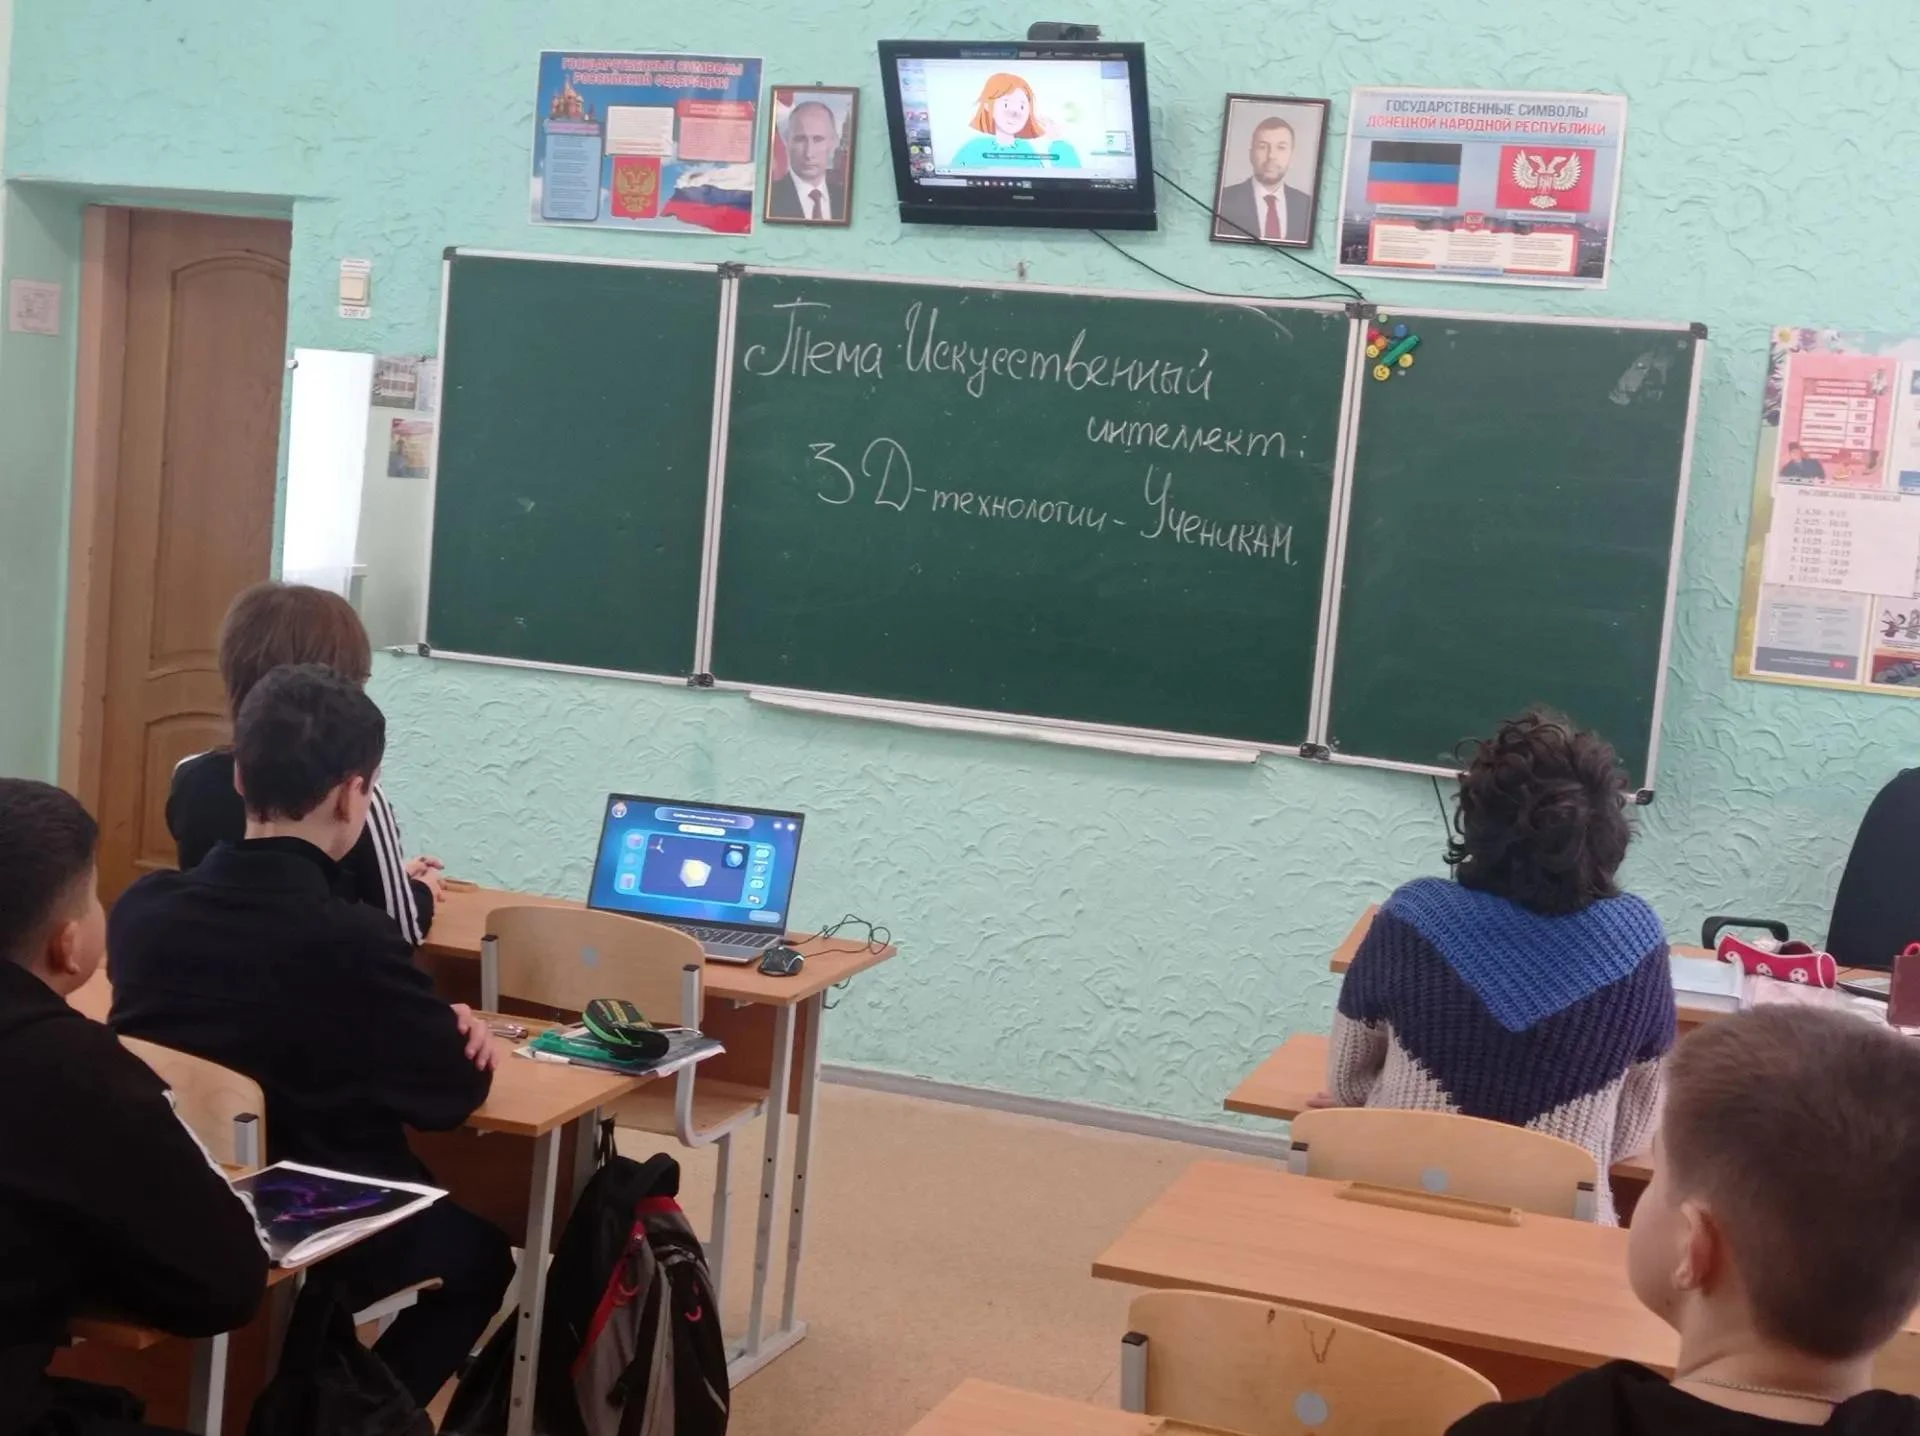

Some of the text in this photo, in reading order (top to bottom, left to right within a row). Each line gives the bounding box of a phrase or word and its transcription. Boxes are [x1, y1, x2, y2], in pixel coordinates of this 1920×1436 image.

[1385, 99, 1588, 119] ГОСУДАРСТВЕННЫЕ СИМВОЛЫ
[1366, 114, 1606, 137] ДОНЕЦКОЙ НАРОДНОЙ РЕСПУБЛИКИ
